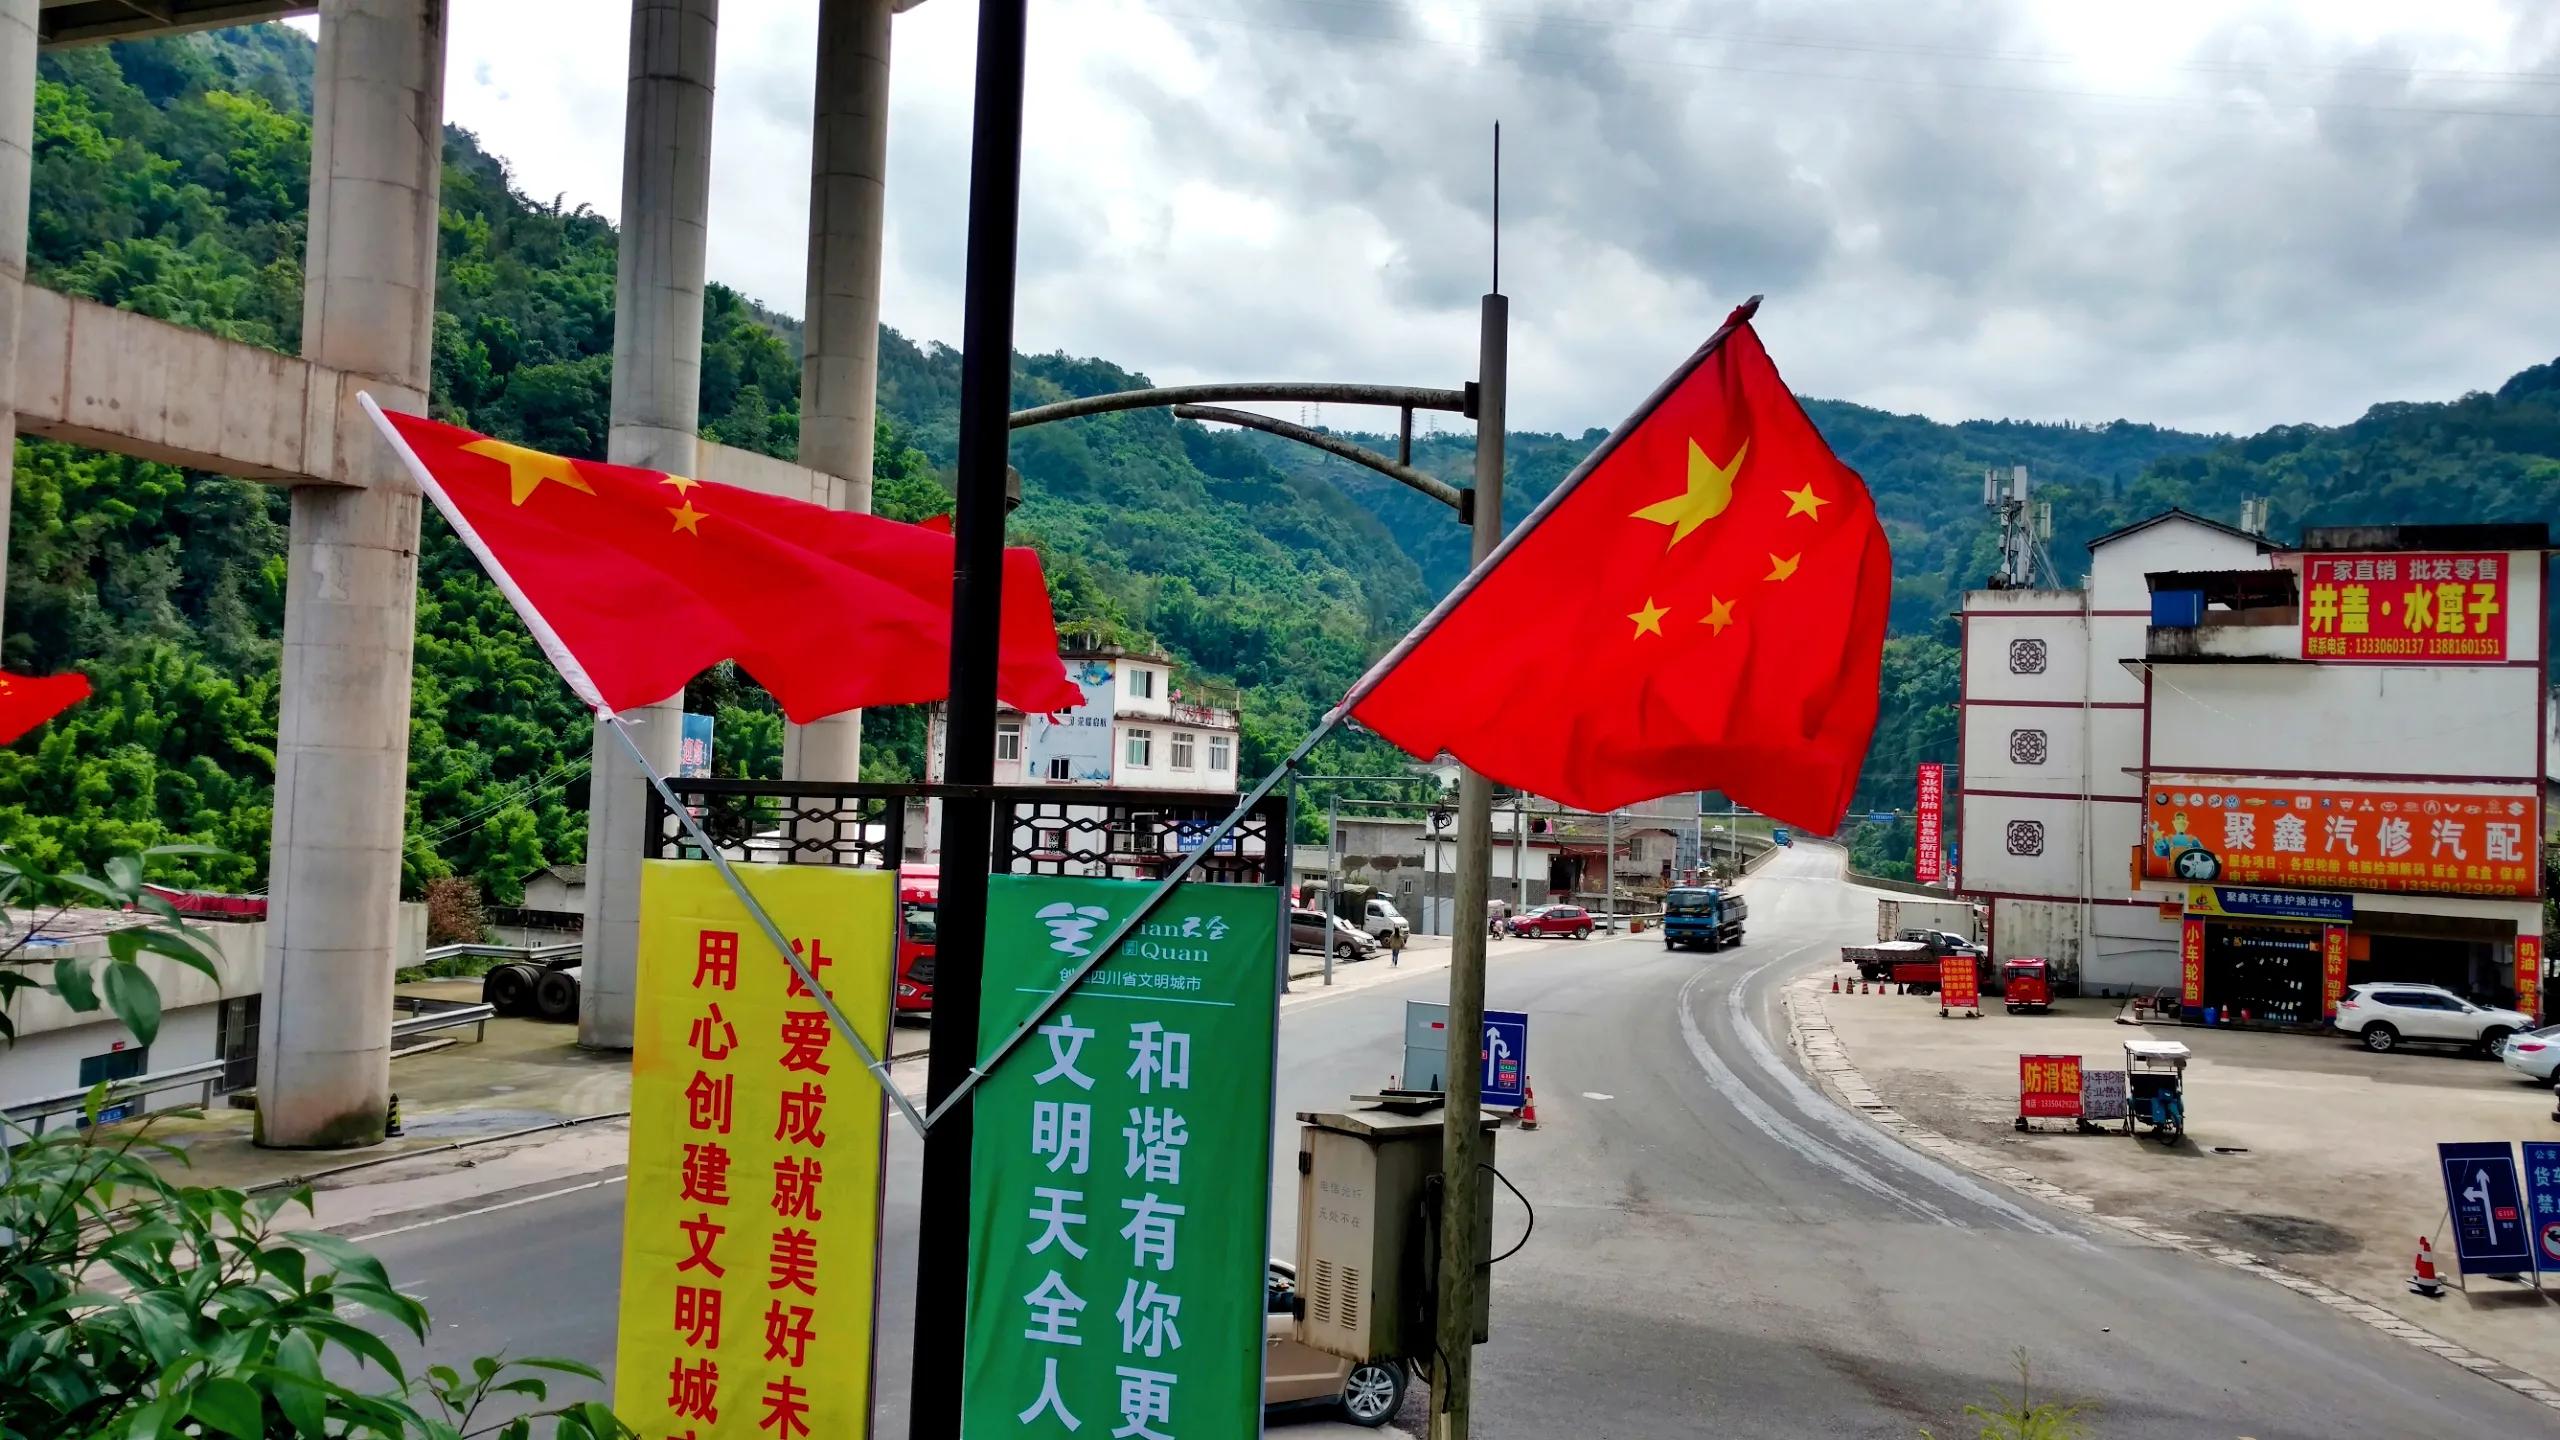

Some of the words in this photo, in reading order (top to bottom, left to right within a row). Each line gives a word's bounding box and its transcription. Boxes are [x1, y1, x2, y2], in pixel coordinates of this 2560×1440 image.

[2312, 560, 2397, 581] 厂家直销
[2409, 559, 2498, 580] 批发零售
[2429, 639, 2499, 655] 13881601551
[2224, 811, 2524, 862] 聚鑫汽修汽配
[2291, 857, 2340, 873] 各型轮胎
[2500, 867, 2527, 882] 保养
[2226, 891, 2343, 909] 聚鑫汽车养护换油中心
[1141, 942, 1208, 963] Quan
[2184, 924, 2200, 1001] 小车轮胎
[2520, 942, 2536, 971] 机油
[1059, 967, 1202, 992] 创四川省文明城市
[2024, 1063, 2079, 1094] 防滑链
[666, 929, 739, 1440] 用心创建文明城
[1018, 1014, 1096, 1433] 文明天全人
[1111, 1021, 1191, 1440] 和谐有你更
